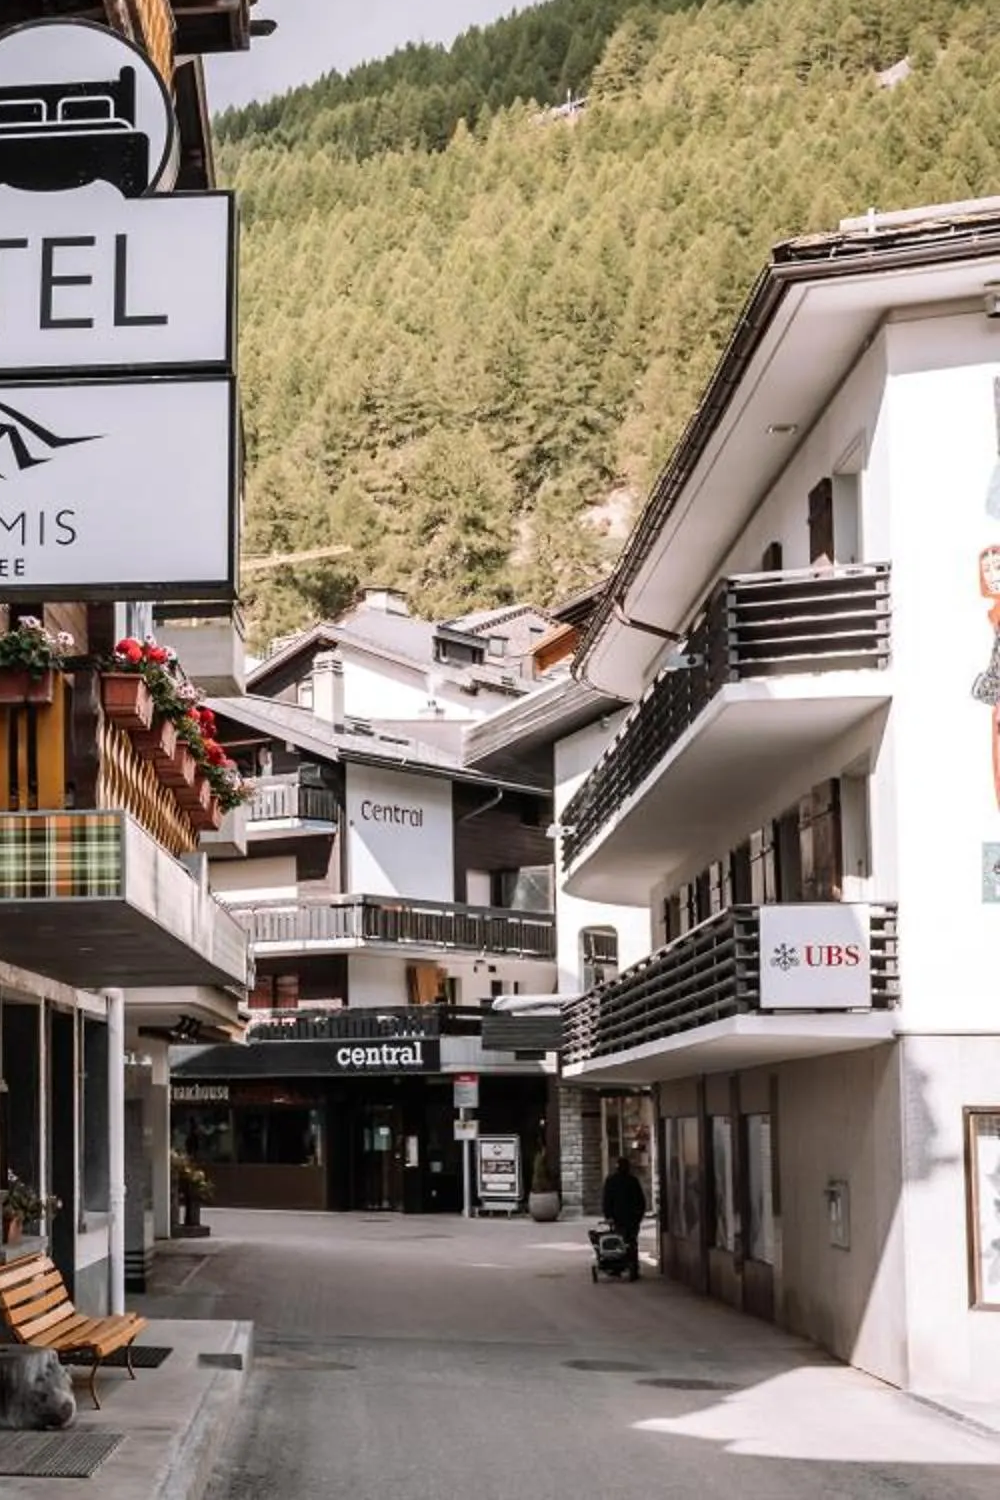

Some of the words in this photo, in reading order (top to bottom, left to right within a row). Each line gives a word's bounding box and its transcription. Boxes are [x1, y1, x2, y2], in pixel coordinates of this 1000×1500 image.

[361, 800, 423, 827] Central
[804, 944, 859, 967] UBS
[336, 1041, 424, 1066] central
